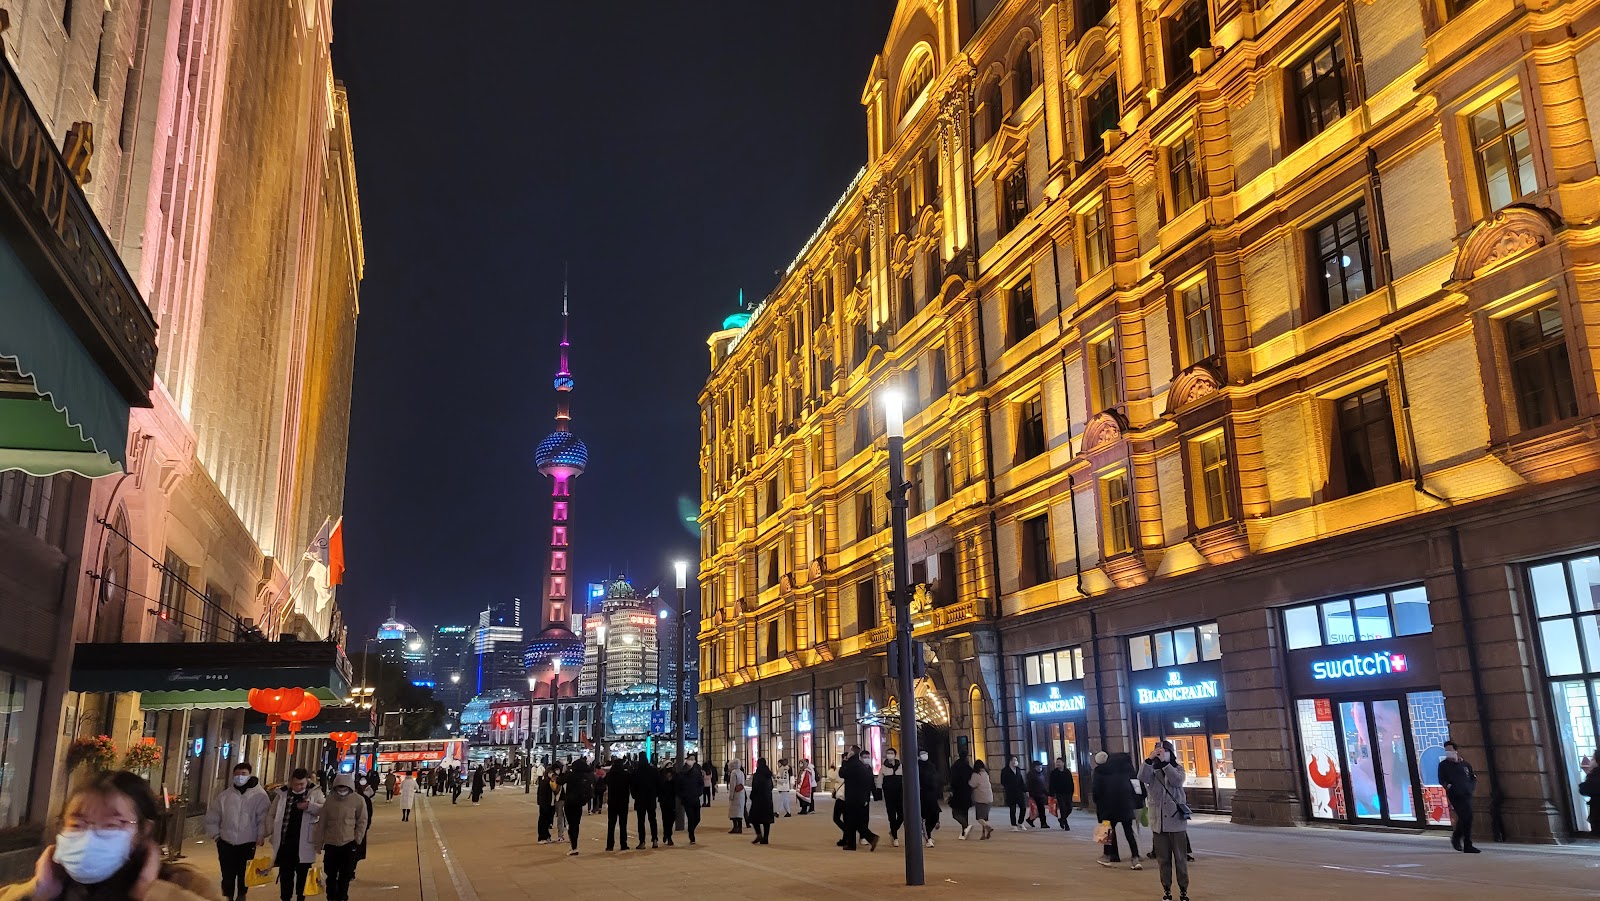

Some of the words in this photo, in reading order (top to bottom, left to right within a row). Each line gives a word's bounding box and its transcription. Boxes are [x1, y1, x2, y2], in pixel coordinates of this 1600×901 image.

[1331, 633, 1375, 643] swach
[1313, 651, 1391, 680] swatch
[1137, 681, 1218, 704] BLANCPAIN
[1028, 695, 1086, 714] BLANCPAIN
